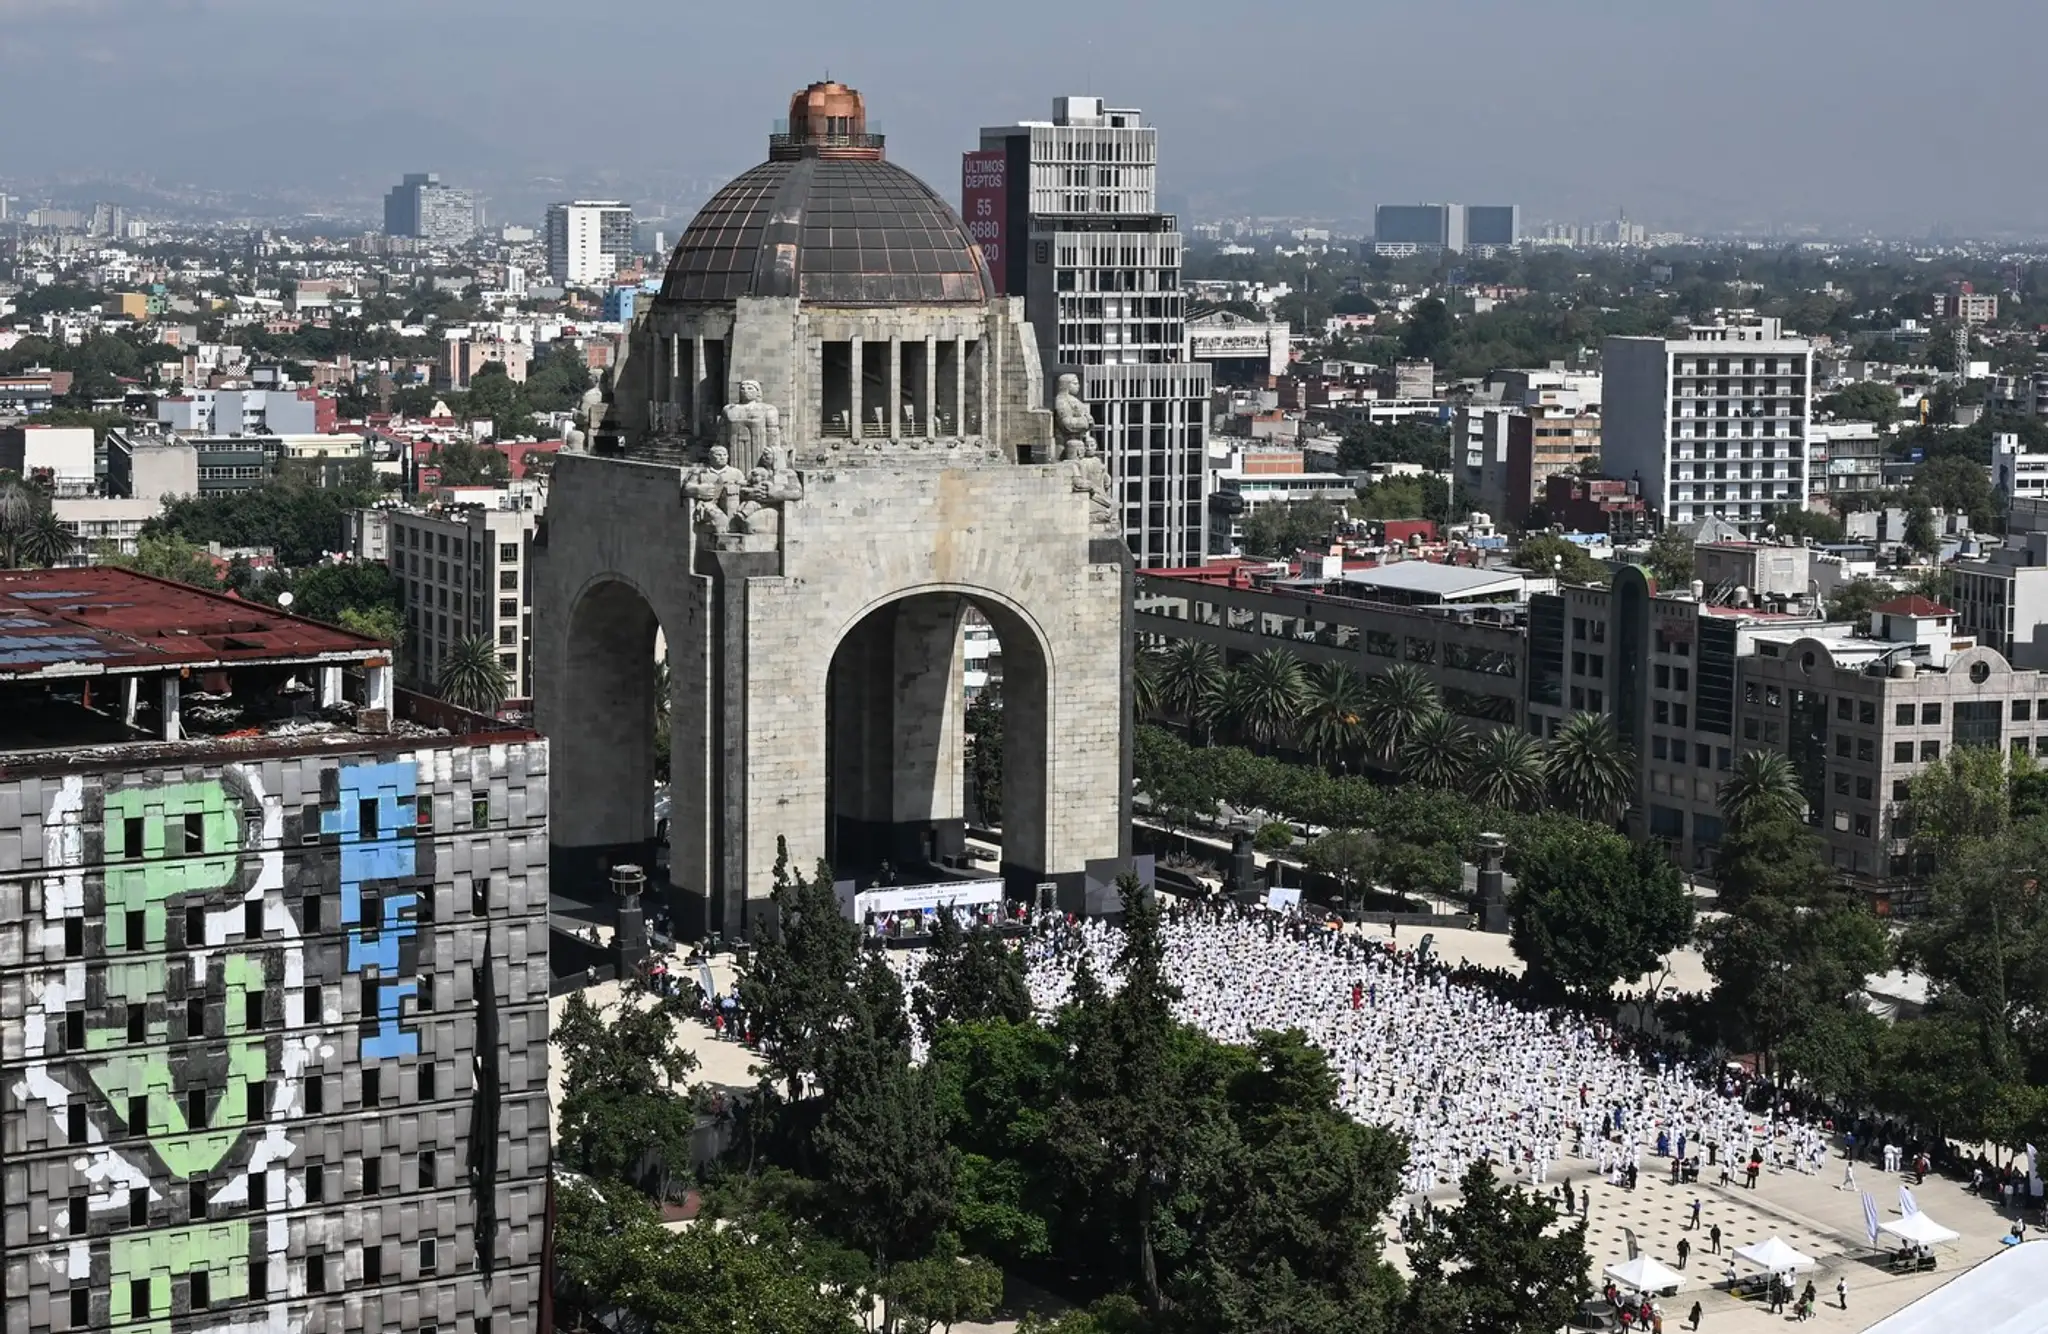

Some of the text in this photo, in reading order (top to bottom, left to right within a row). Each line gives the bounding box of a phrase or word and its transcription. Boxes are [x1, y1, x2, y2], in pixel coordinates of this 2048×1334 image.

[965, 157, 1004, 173] ÚLTIMOS
[965, 175, 1002, 188] DEPTOS
[977, 199, 992, 216] 55
[970, 221, 999, 238] 6680
